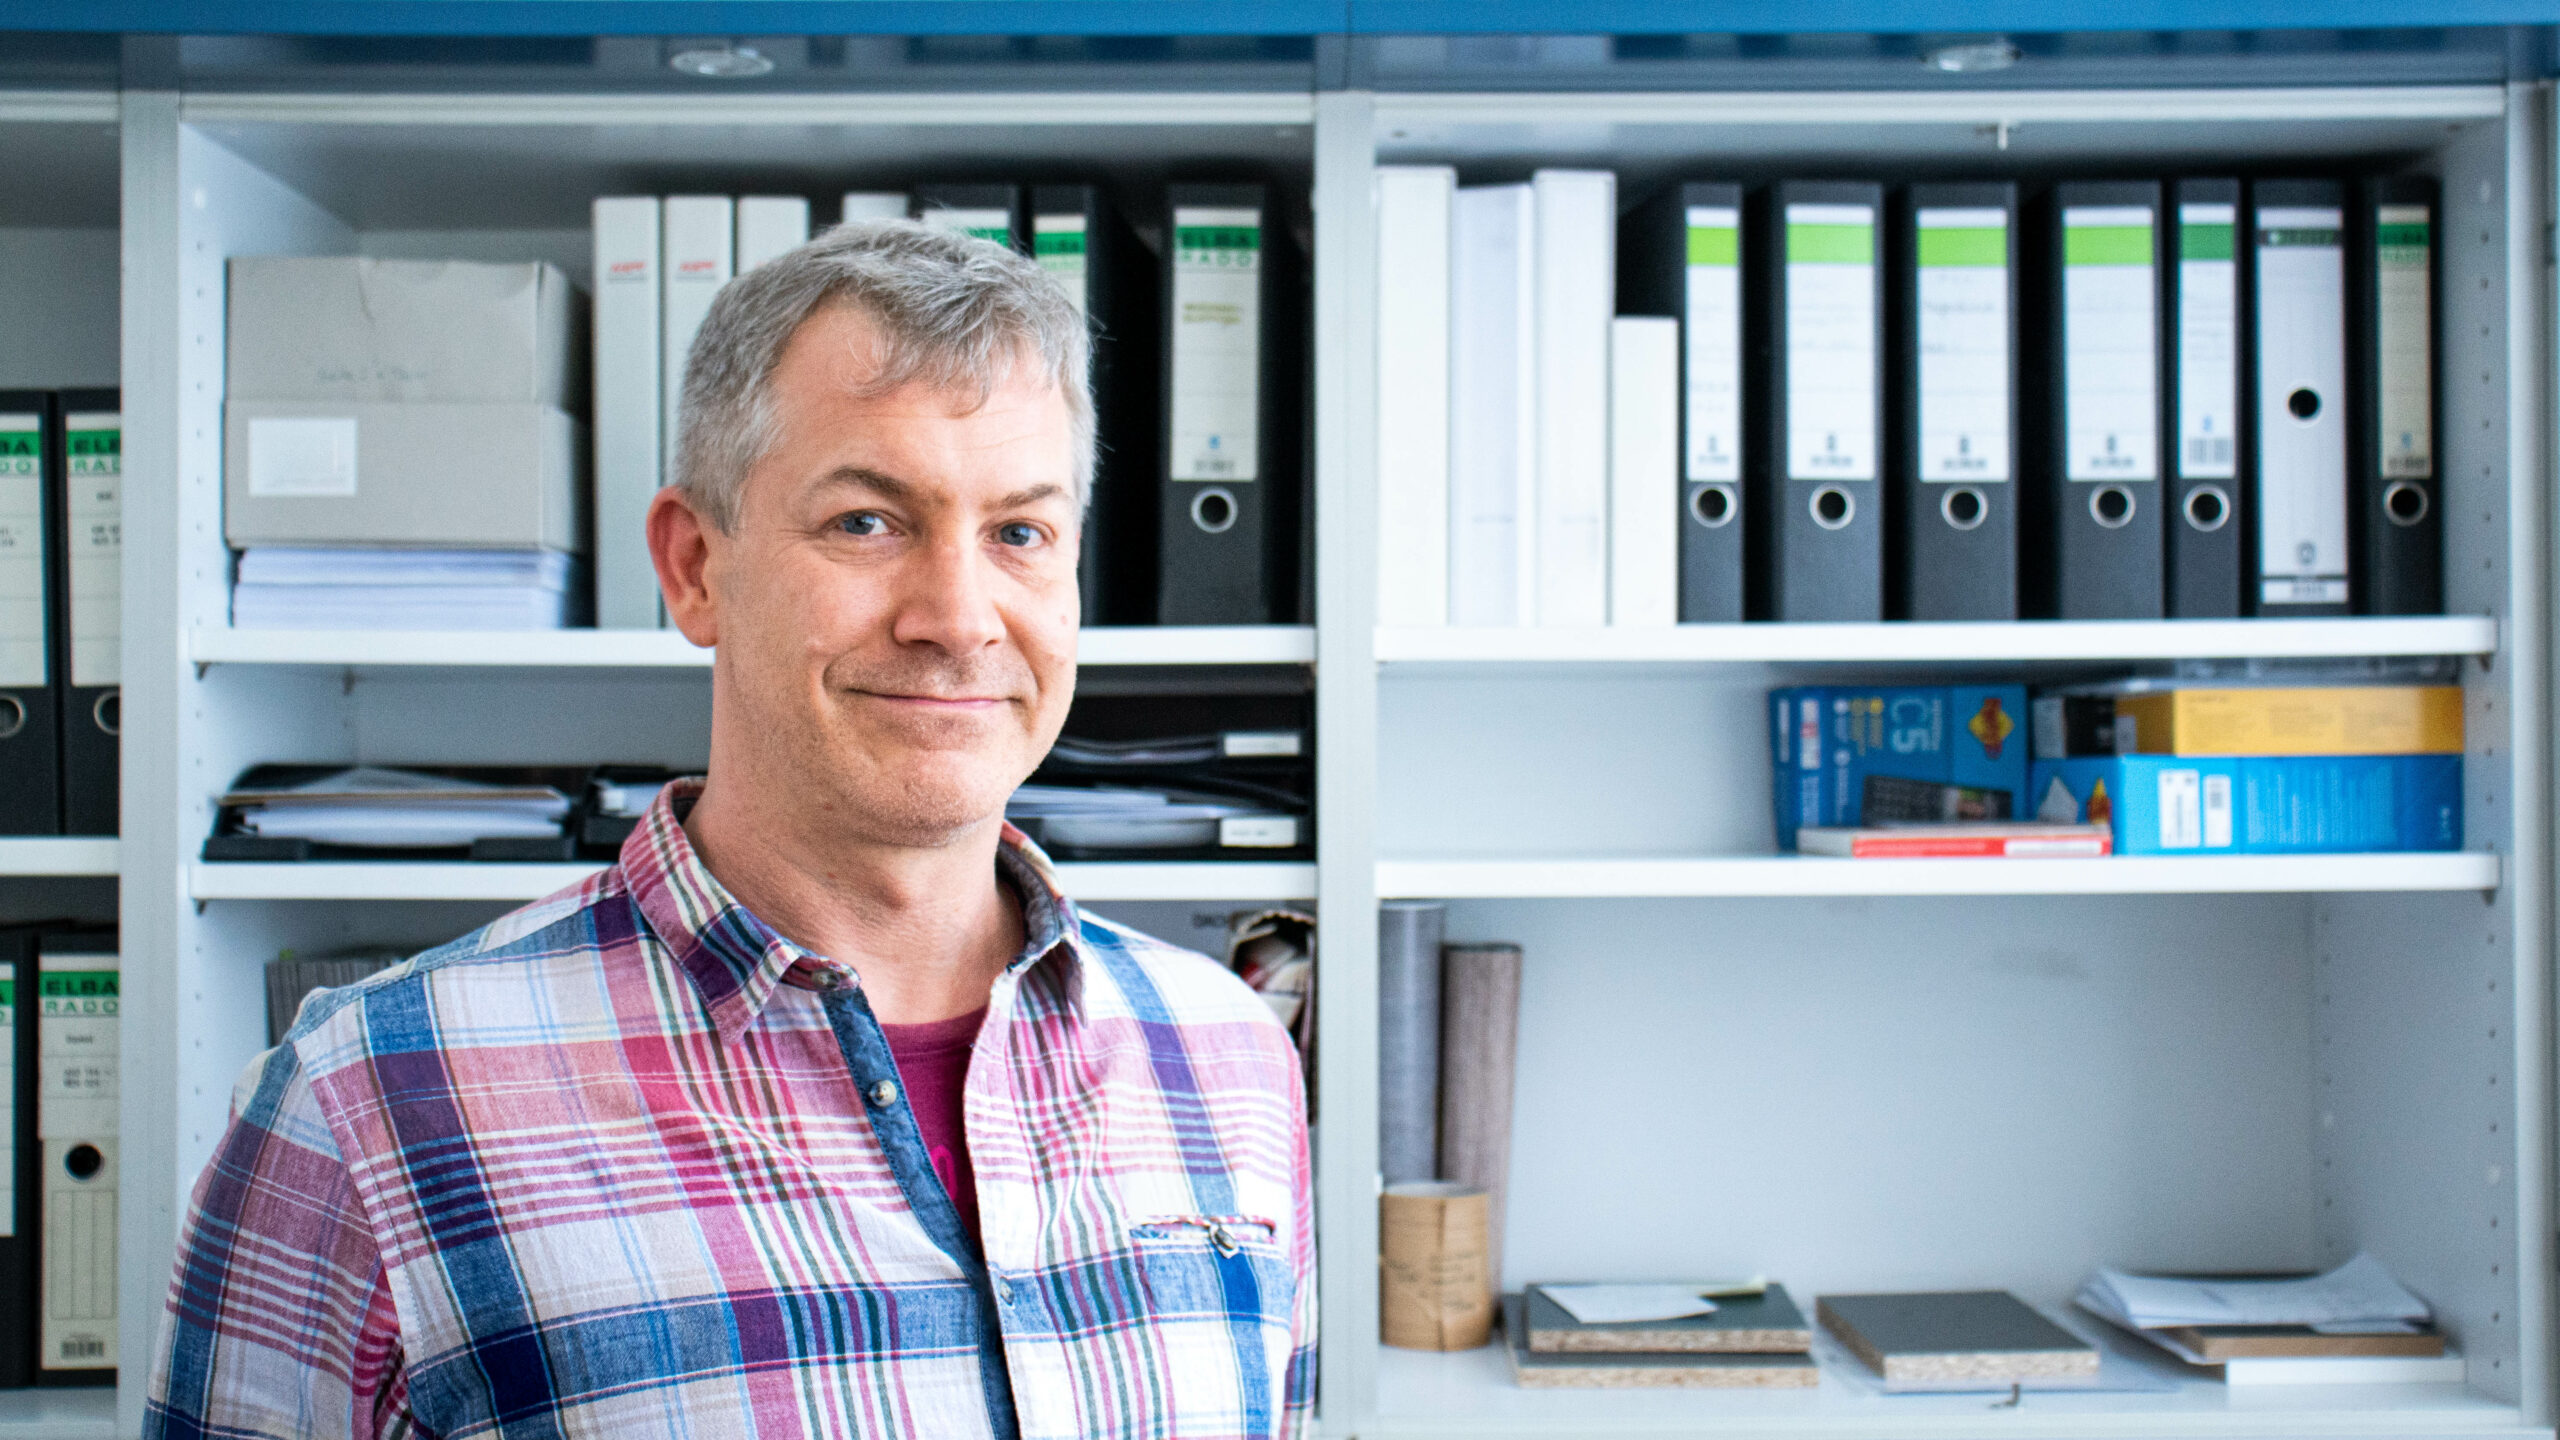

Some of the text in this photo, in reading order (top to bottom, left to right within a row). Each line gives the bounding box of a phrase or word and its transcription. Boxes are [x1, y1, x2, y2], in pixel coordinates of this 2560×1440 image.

[1182, 232, 1251, 248] ELBA
[1892, 696, 1930, 753] C5
[46, 980, 118, 996] ELBA
[45, 1000, 118, 1014] RADO
